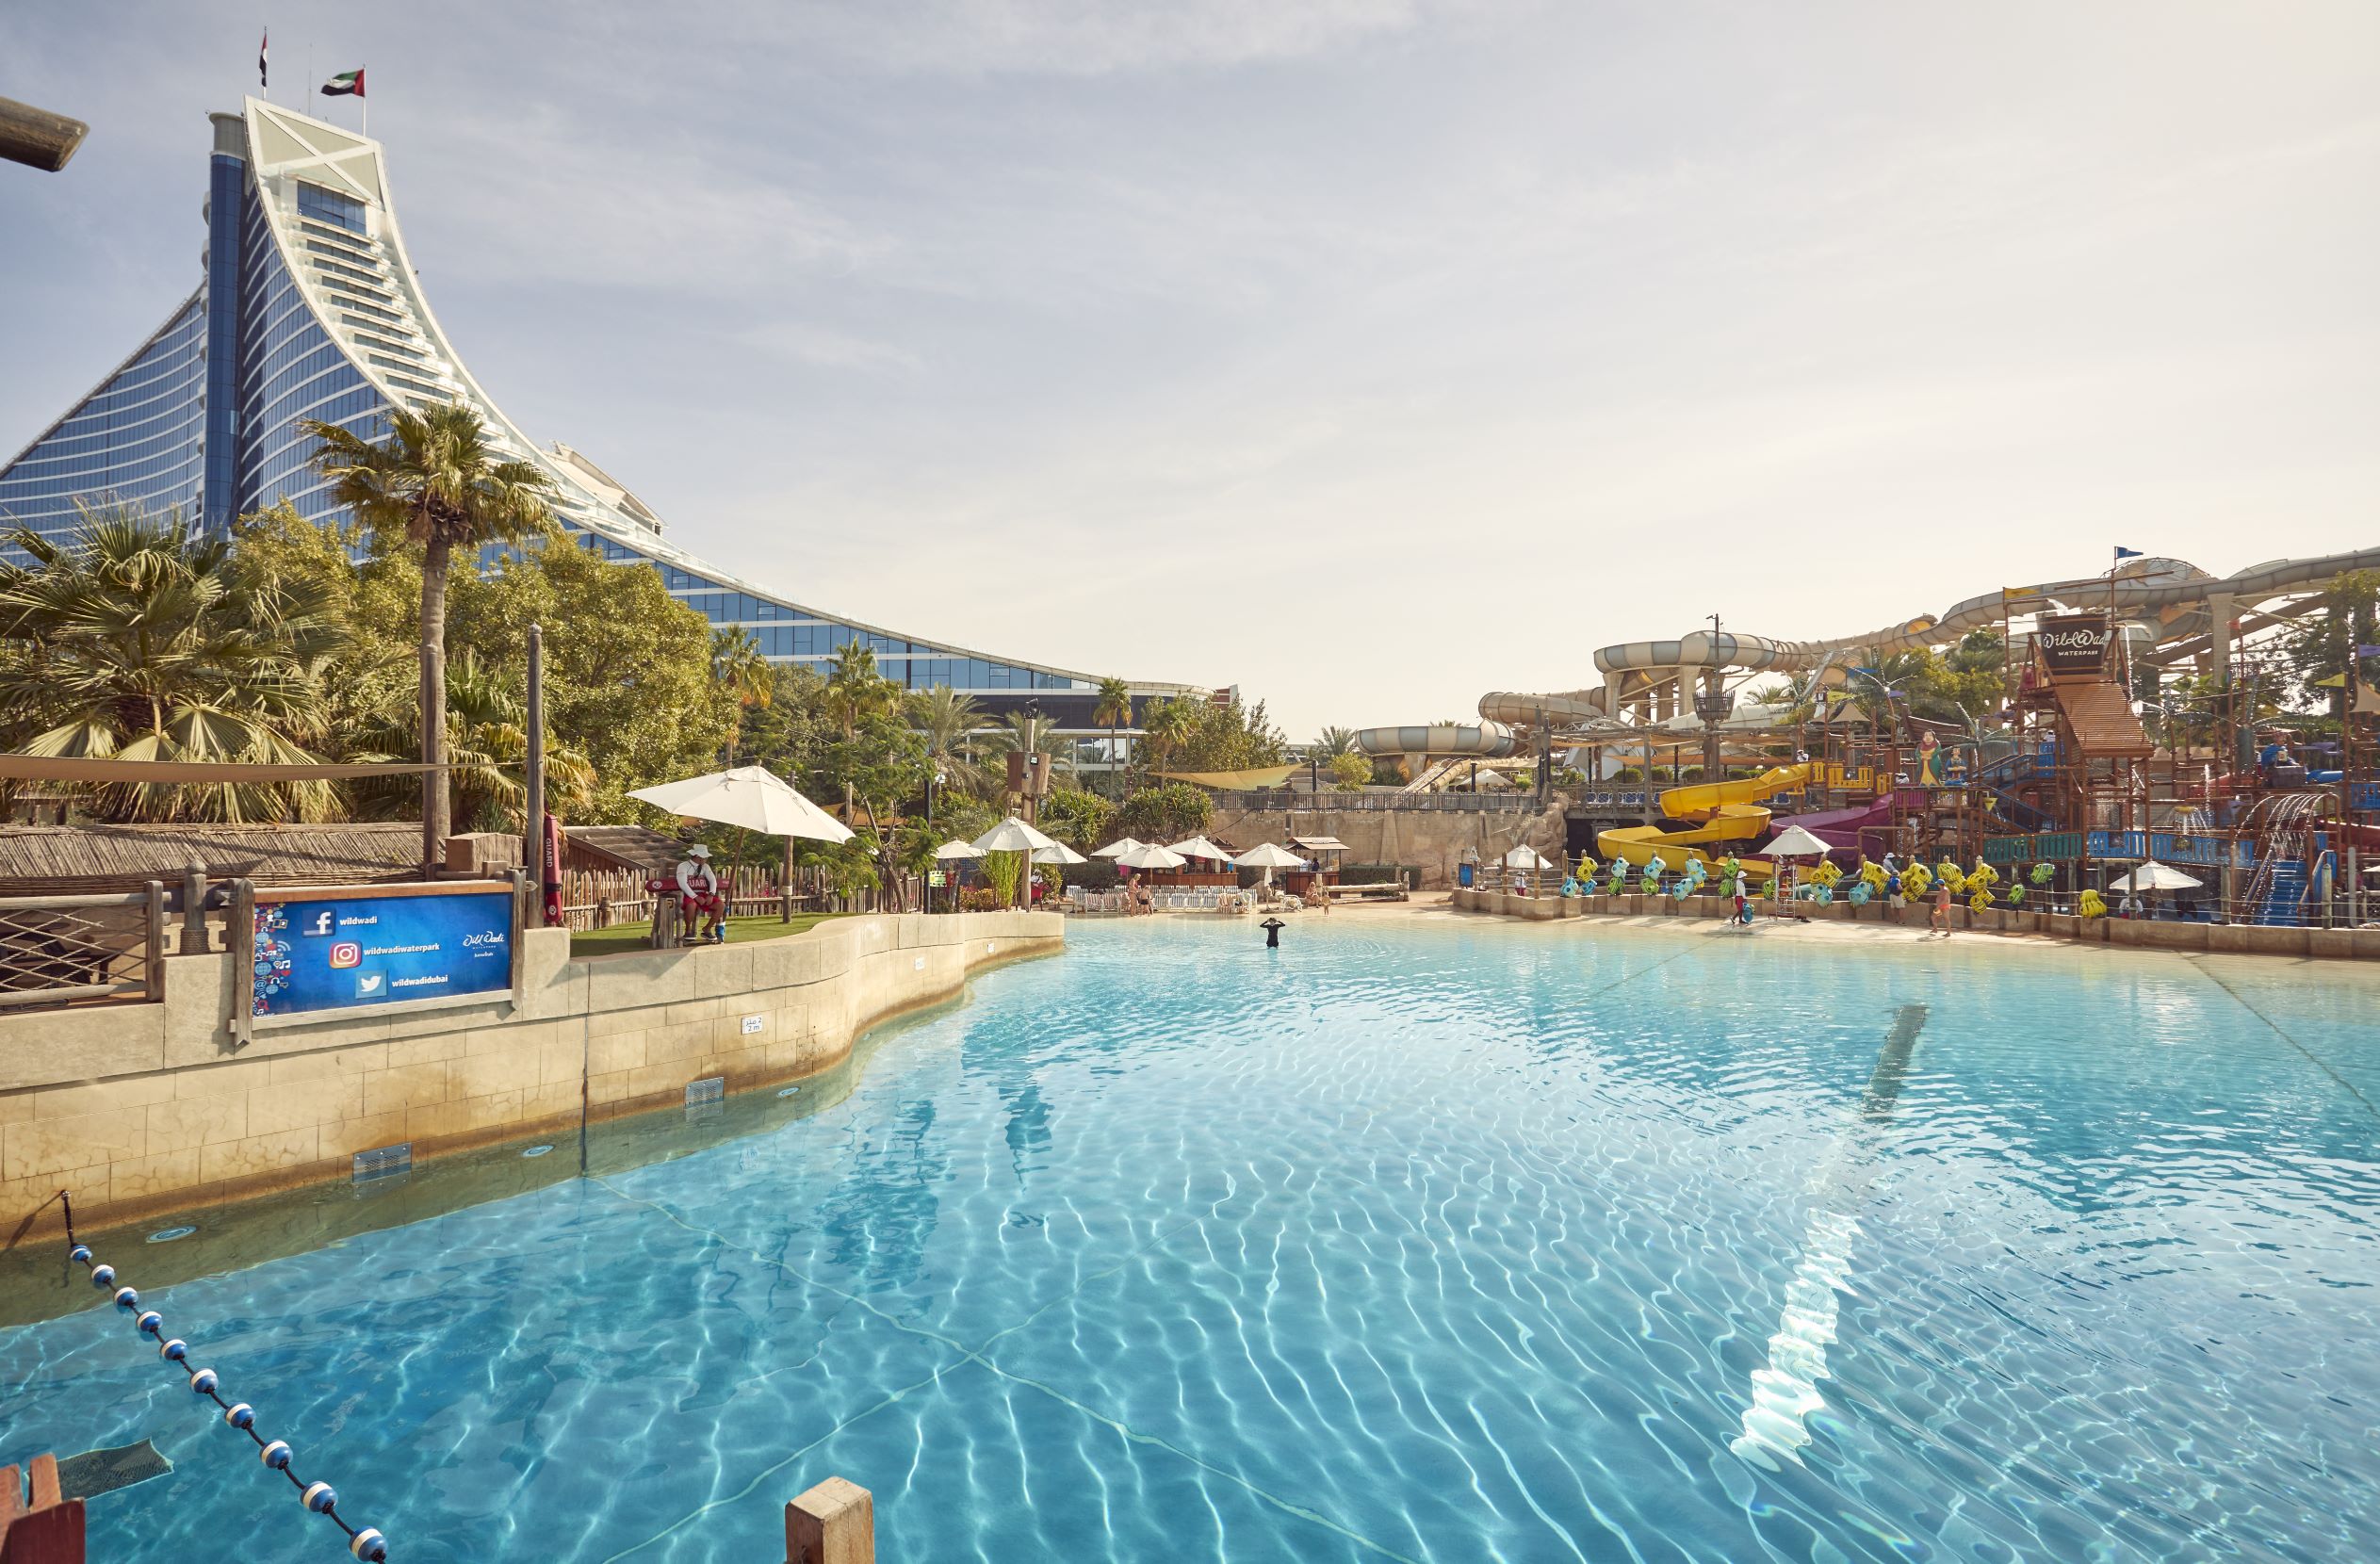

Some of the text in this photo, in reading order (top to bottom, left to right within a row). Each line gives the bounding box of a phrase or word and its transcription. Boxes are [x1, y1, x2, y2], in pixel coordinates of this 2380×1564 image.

[2043, 629, 2106, 648] Wild Wad
[339, 916, 378, 926] wildwadi
[364, 943, 440, 955] wildwadiwaterpark
[391, 974, 448, 987] wildwadidubai
